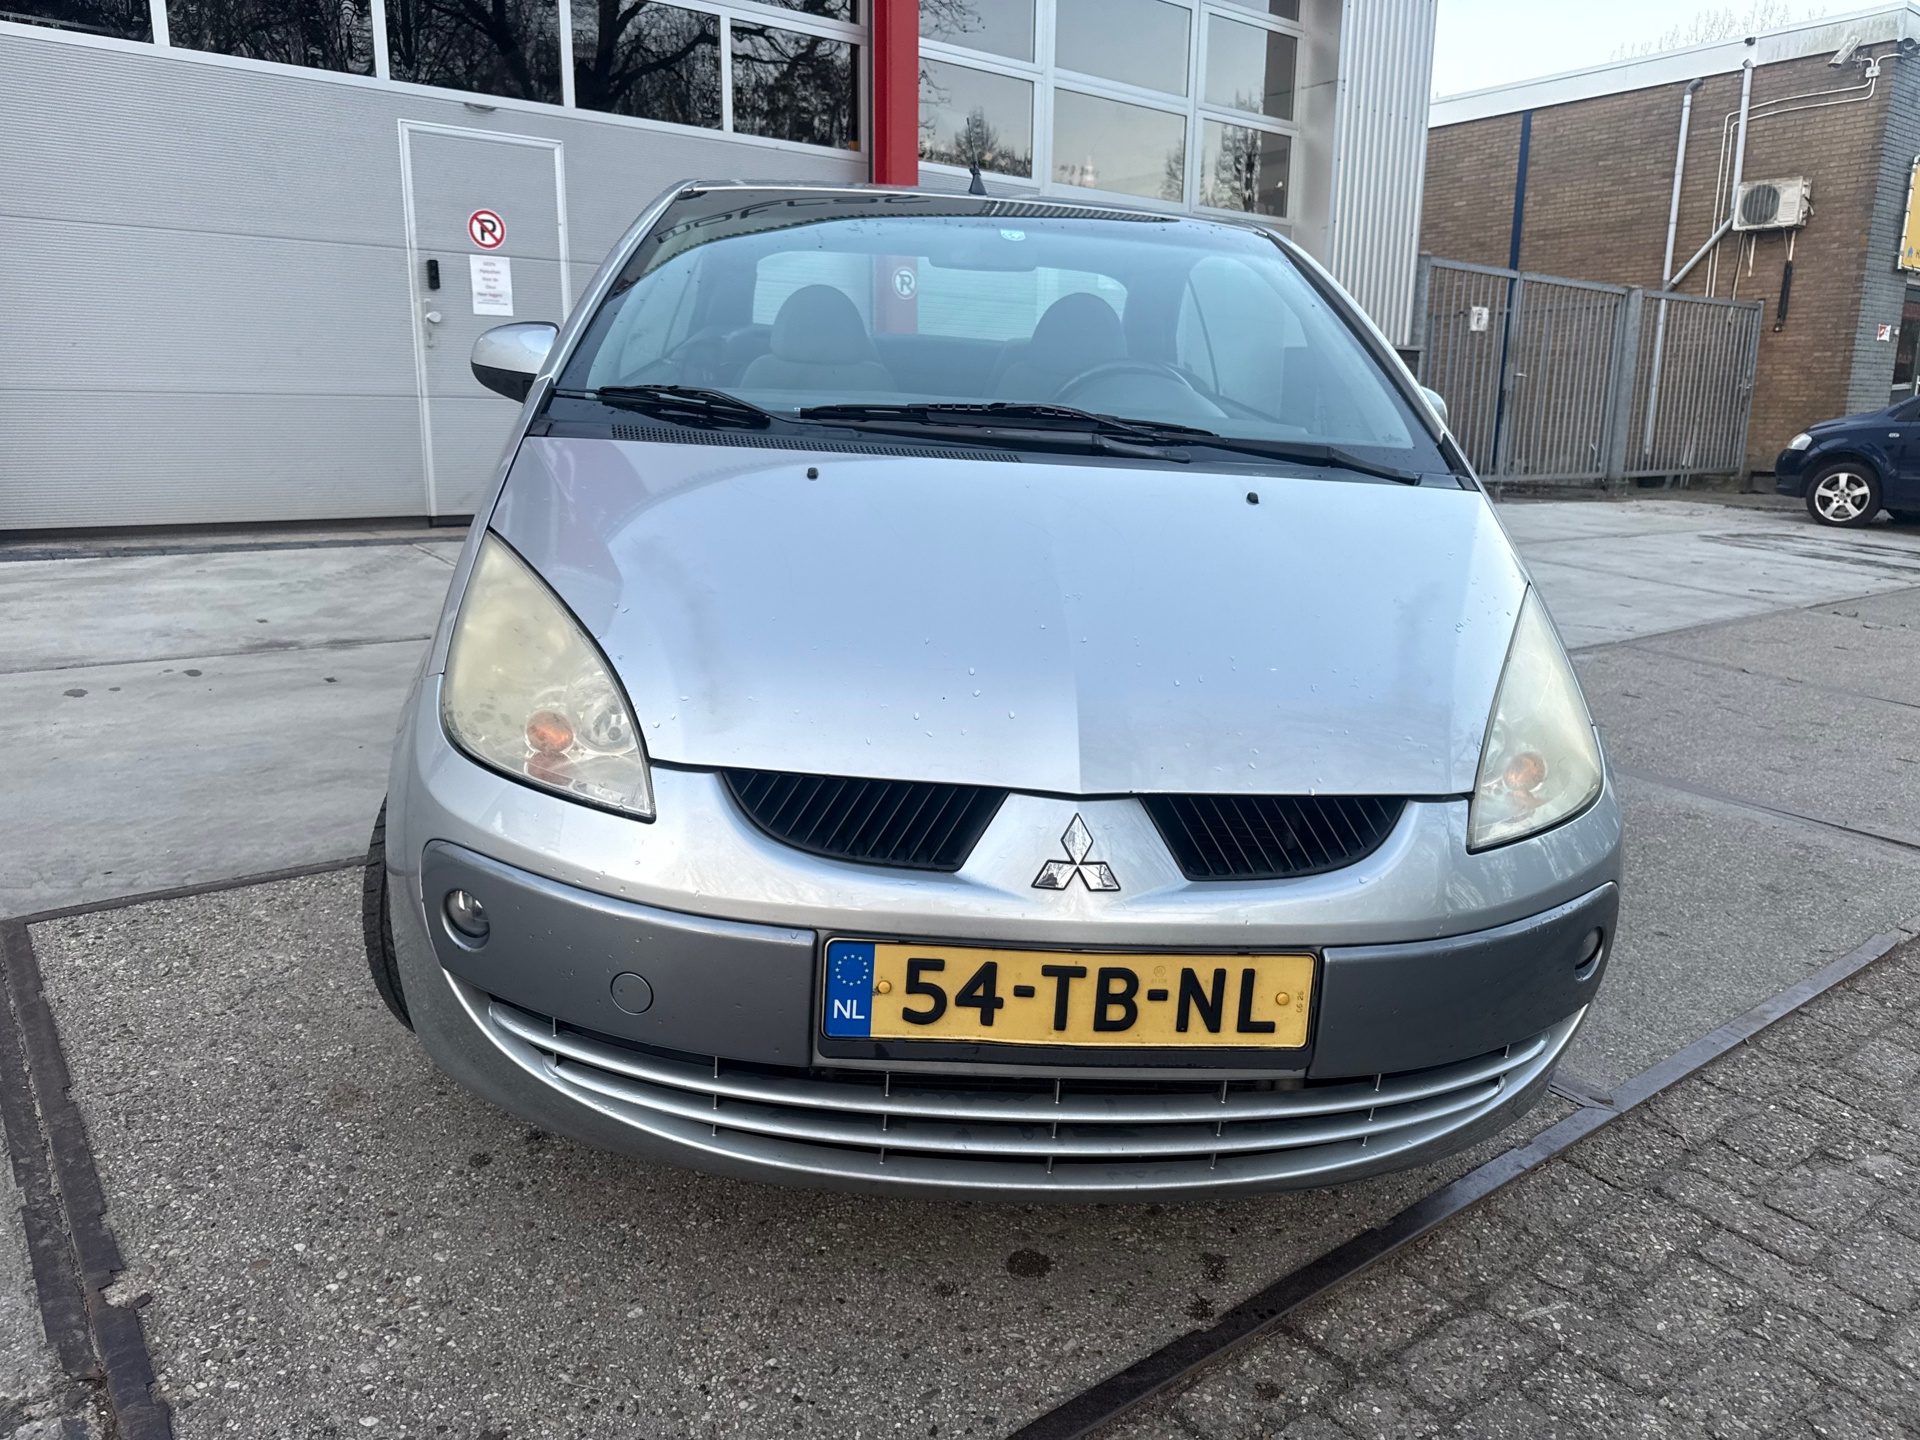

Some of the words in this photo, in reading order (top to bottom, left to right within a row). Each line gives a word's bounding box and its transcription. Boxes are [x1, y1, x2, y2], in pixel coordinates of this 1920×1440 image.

[480, 219, 496, 241] P
[902, 958, 1275, 1033] 54-TB-NL
[833, 999, 865, 1020] NL
